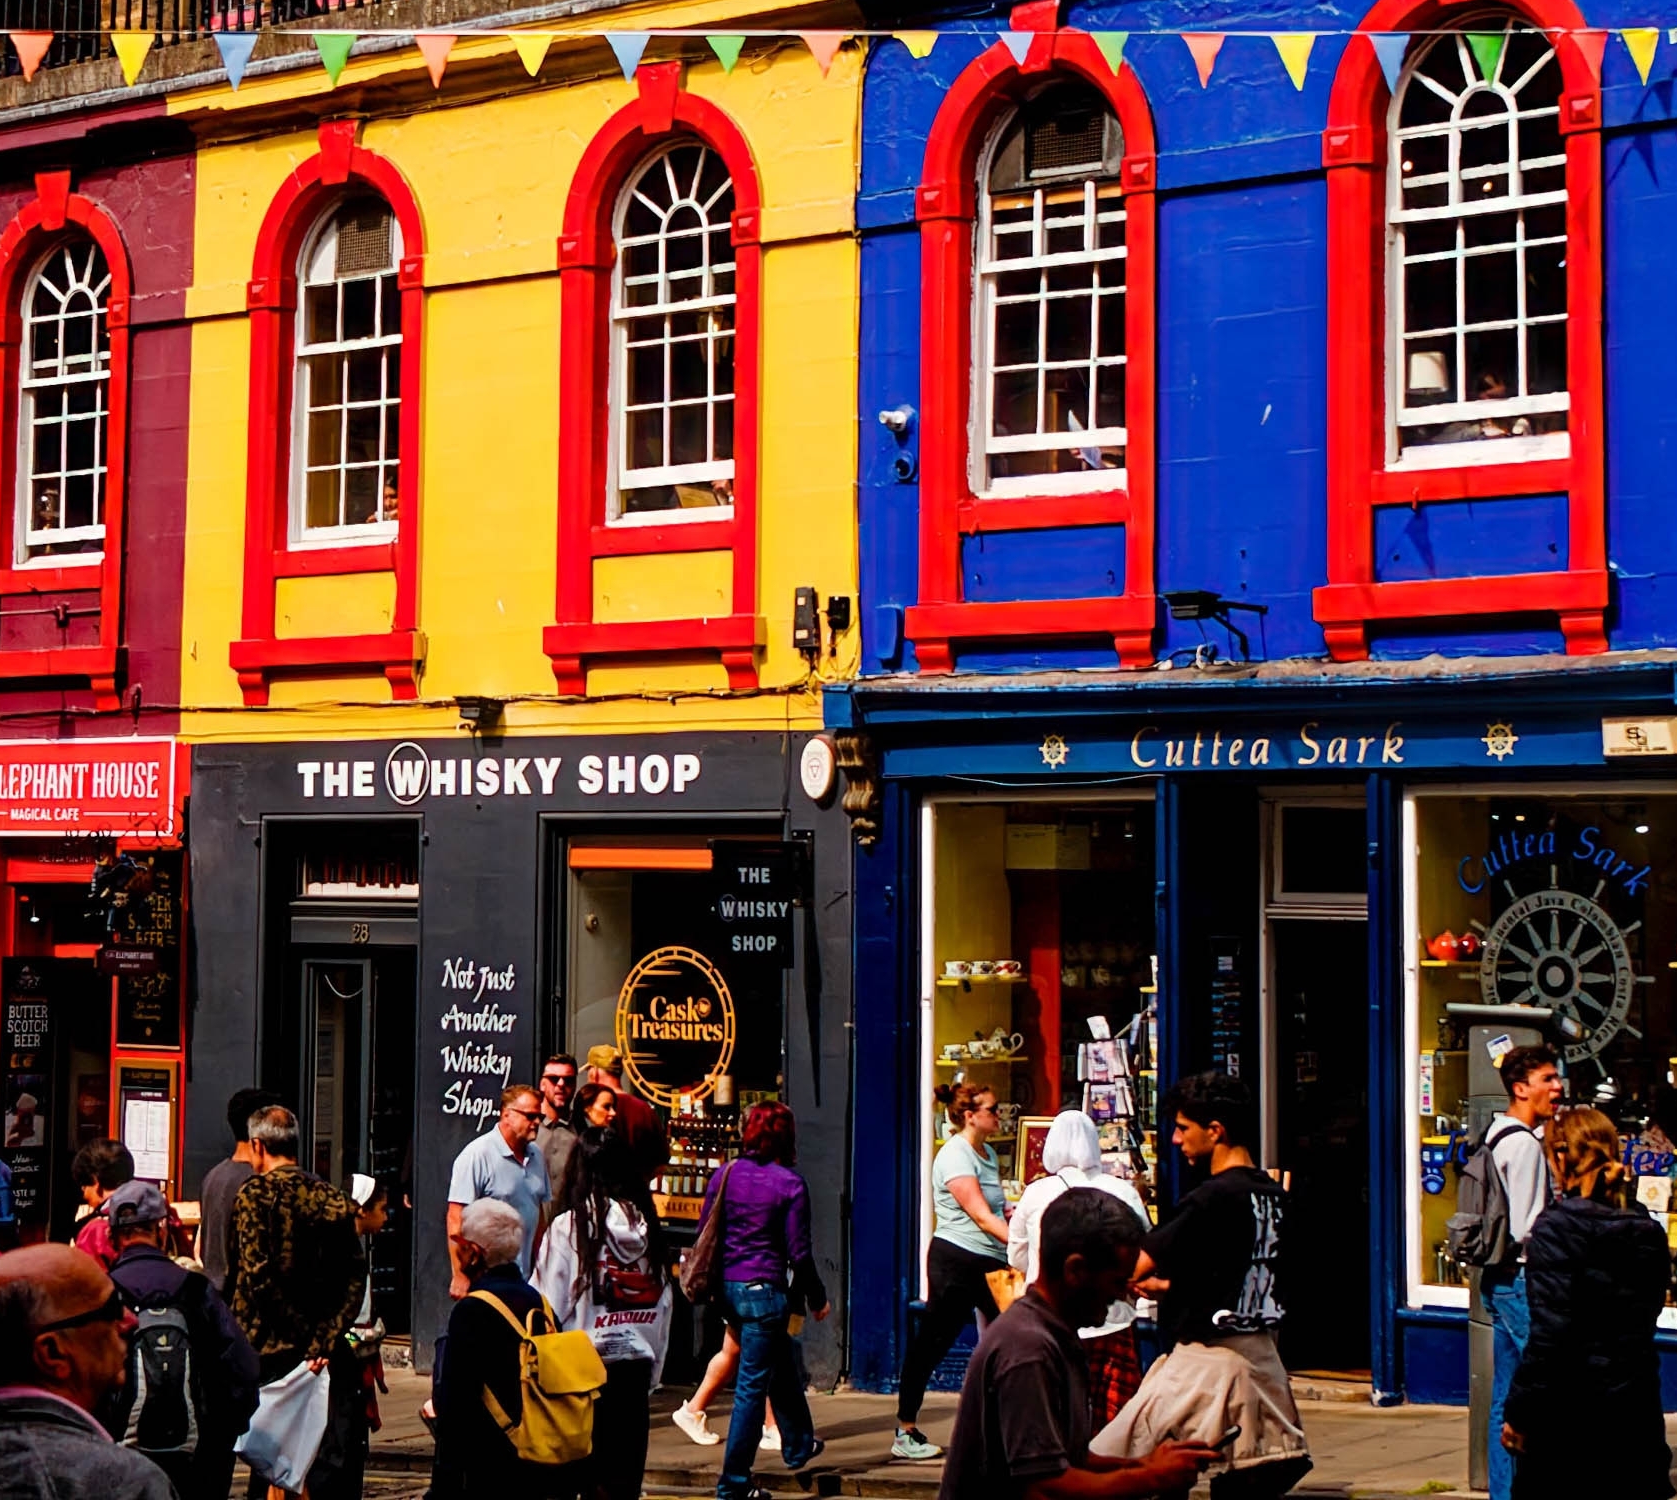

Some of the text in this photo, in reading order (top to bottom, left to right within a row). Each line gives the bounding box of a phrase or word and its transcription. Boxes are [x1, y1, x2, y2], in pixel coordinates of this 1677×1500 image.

[1130, 721, 1405, 768] Cuttea Sark
[92, 761, 160, 799] HOUSE
[297, 754, 701, 798] THE WHISKY SHOP
[10, 807, 80, 821] MAGICAL CAFE
[738, 867, 771, 884] THE
[1457, 826, 1652, 897] Cuttea Sark
[720, 900, 789, 918] WHISKY
[731, 935, 777, 952] SHOP
[441, 956, 475, 991] Not
[8, 1004, 49, 1019] BUTTER
[441, 1003, 518, 1033] Another
[650, 995, 701, 1022] Cask
[7, 1019, 49, 1034] SCOTCH
[14, 1033, 42, 1048] BEER
[627, 1013, 724, 1042] Treasures
[441, 1040, 513, 1090] Whisky
